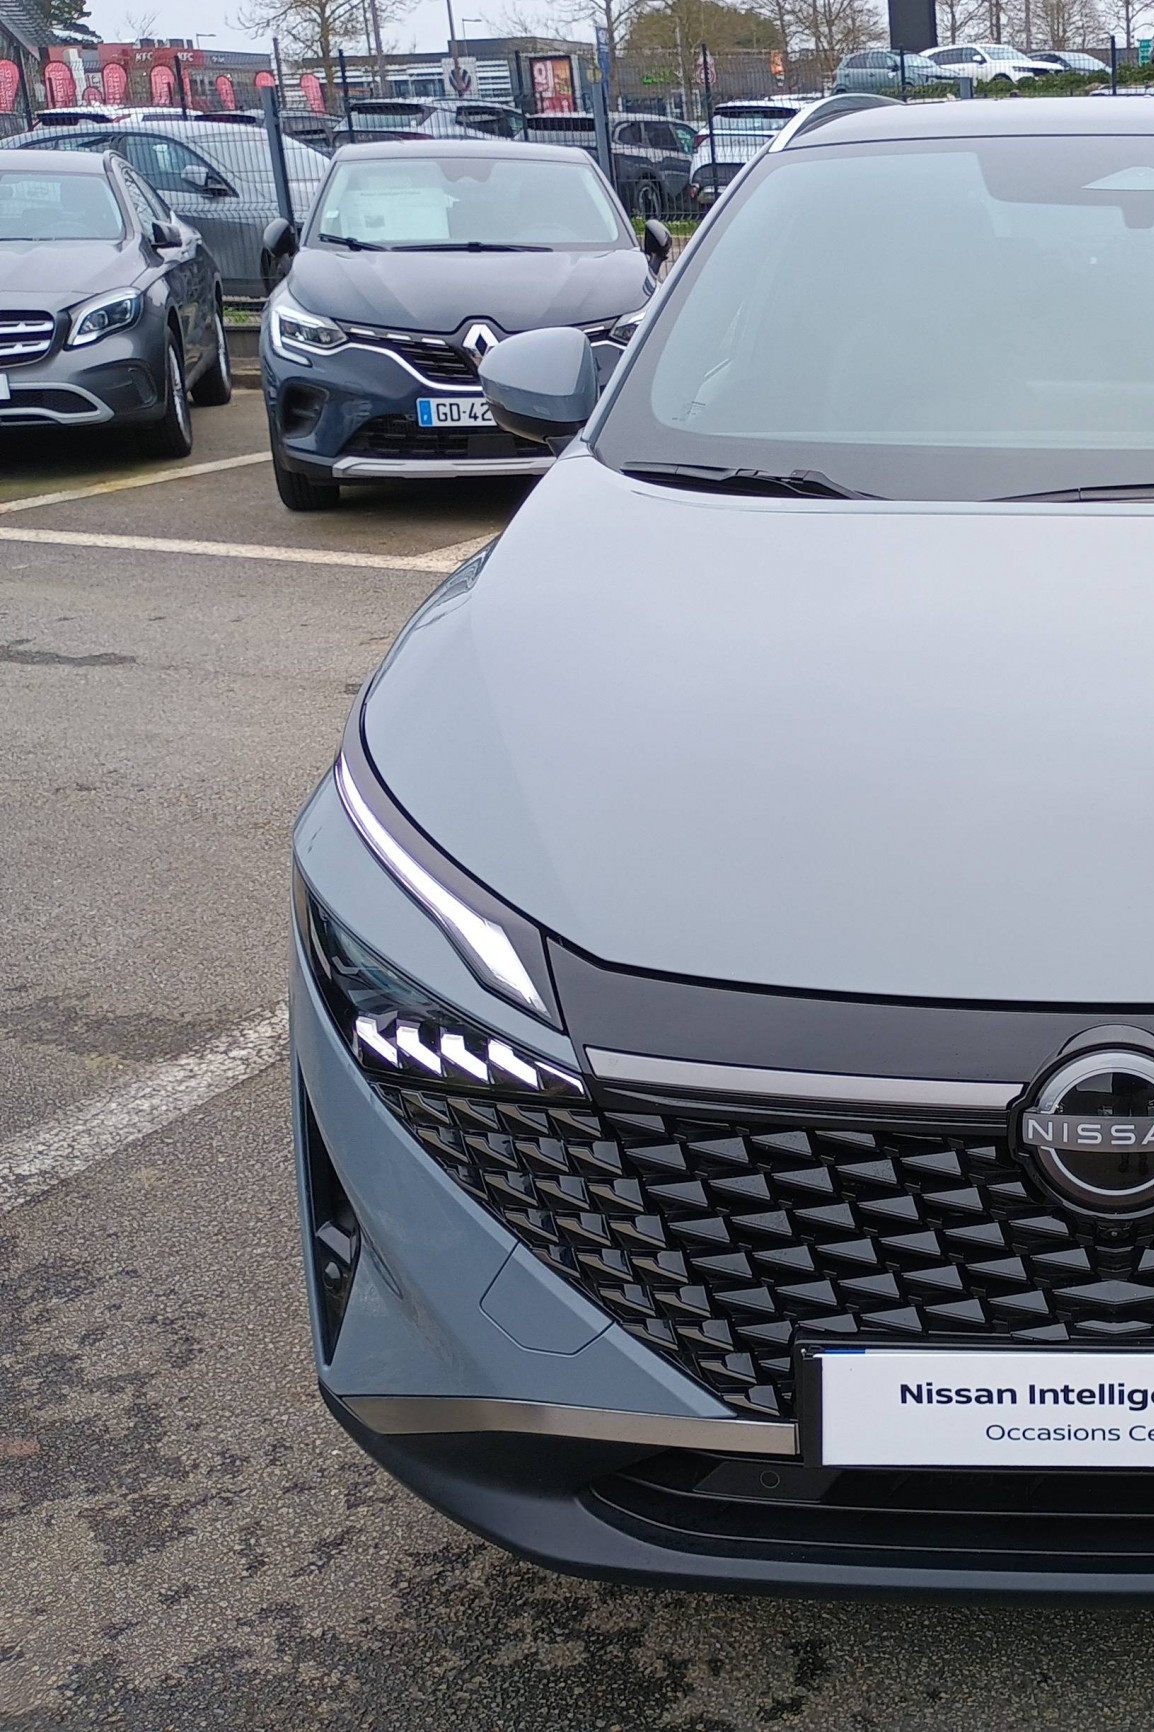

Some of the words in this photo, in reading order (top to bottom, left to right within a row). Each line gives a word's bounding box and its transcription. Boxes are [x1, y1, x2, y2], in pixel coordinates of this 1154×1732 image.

[135, 52, 154, 62] KFC
[176, 52, 194, 62] KFC
[436, 403, 492, 422] GD-42
[900, 1383, 1017, 1405] Nissan
[985, 1424, 1121, 1441] Occasions
